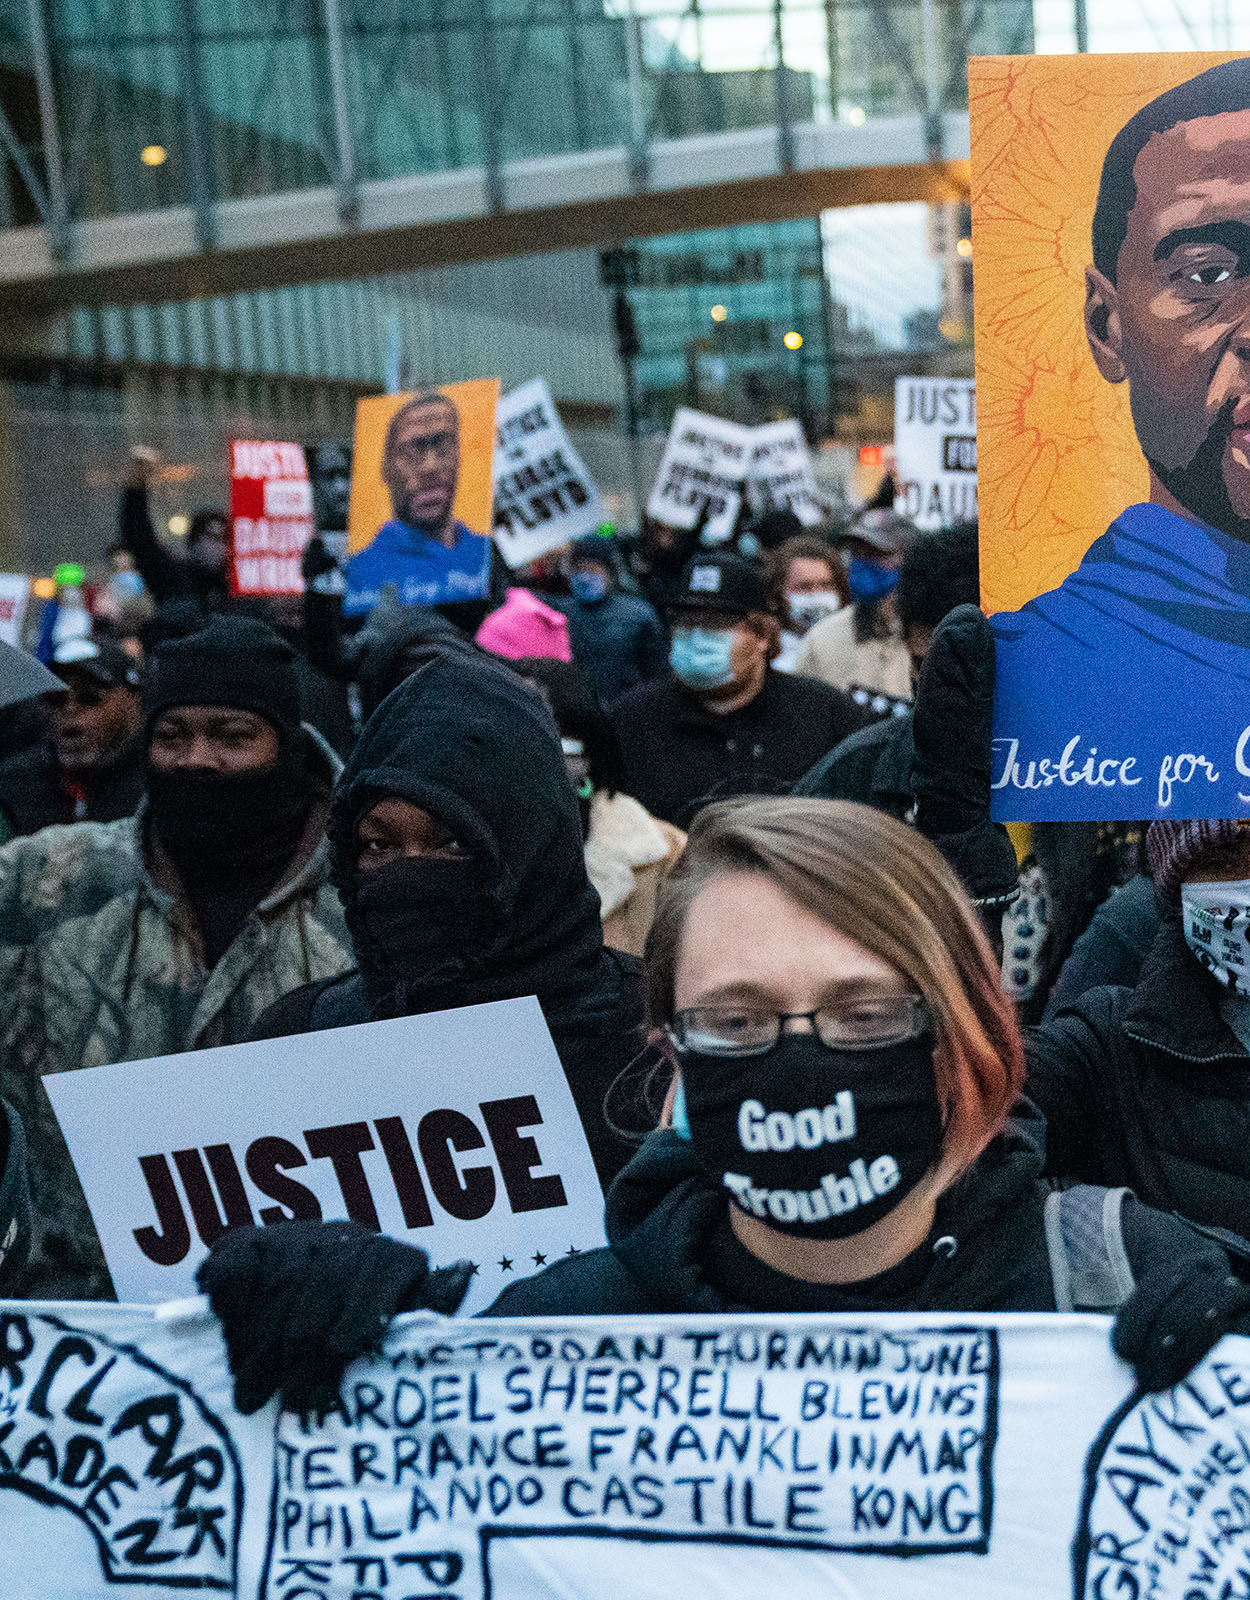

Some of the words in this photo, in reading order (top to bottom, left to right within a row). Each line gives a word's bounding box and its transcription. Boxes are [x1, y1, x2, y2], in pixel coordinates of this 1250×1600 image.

[990, 735, 1142, 790] Justice
[1158, 752, 1219, 807] for
[737, 1089, 857, 1152] Good
[131, 1093, 569, 1267] JUSTICE
[722, 1153, 902, 1223] Trouble
[504, 1363, 781, 1423] SHERRELL
[799, 1376, 979, 1422] BLEVINS
[279, 1422, 570, 1494] TERRANCE
[282, 1471, 546, 1556] PHILANDO
[563, 1472, 828, 1534] CASTILE
[851, 1481, 977, 1538] KONG
